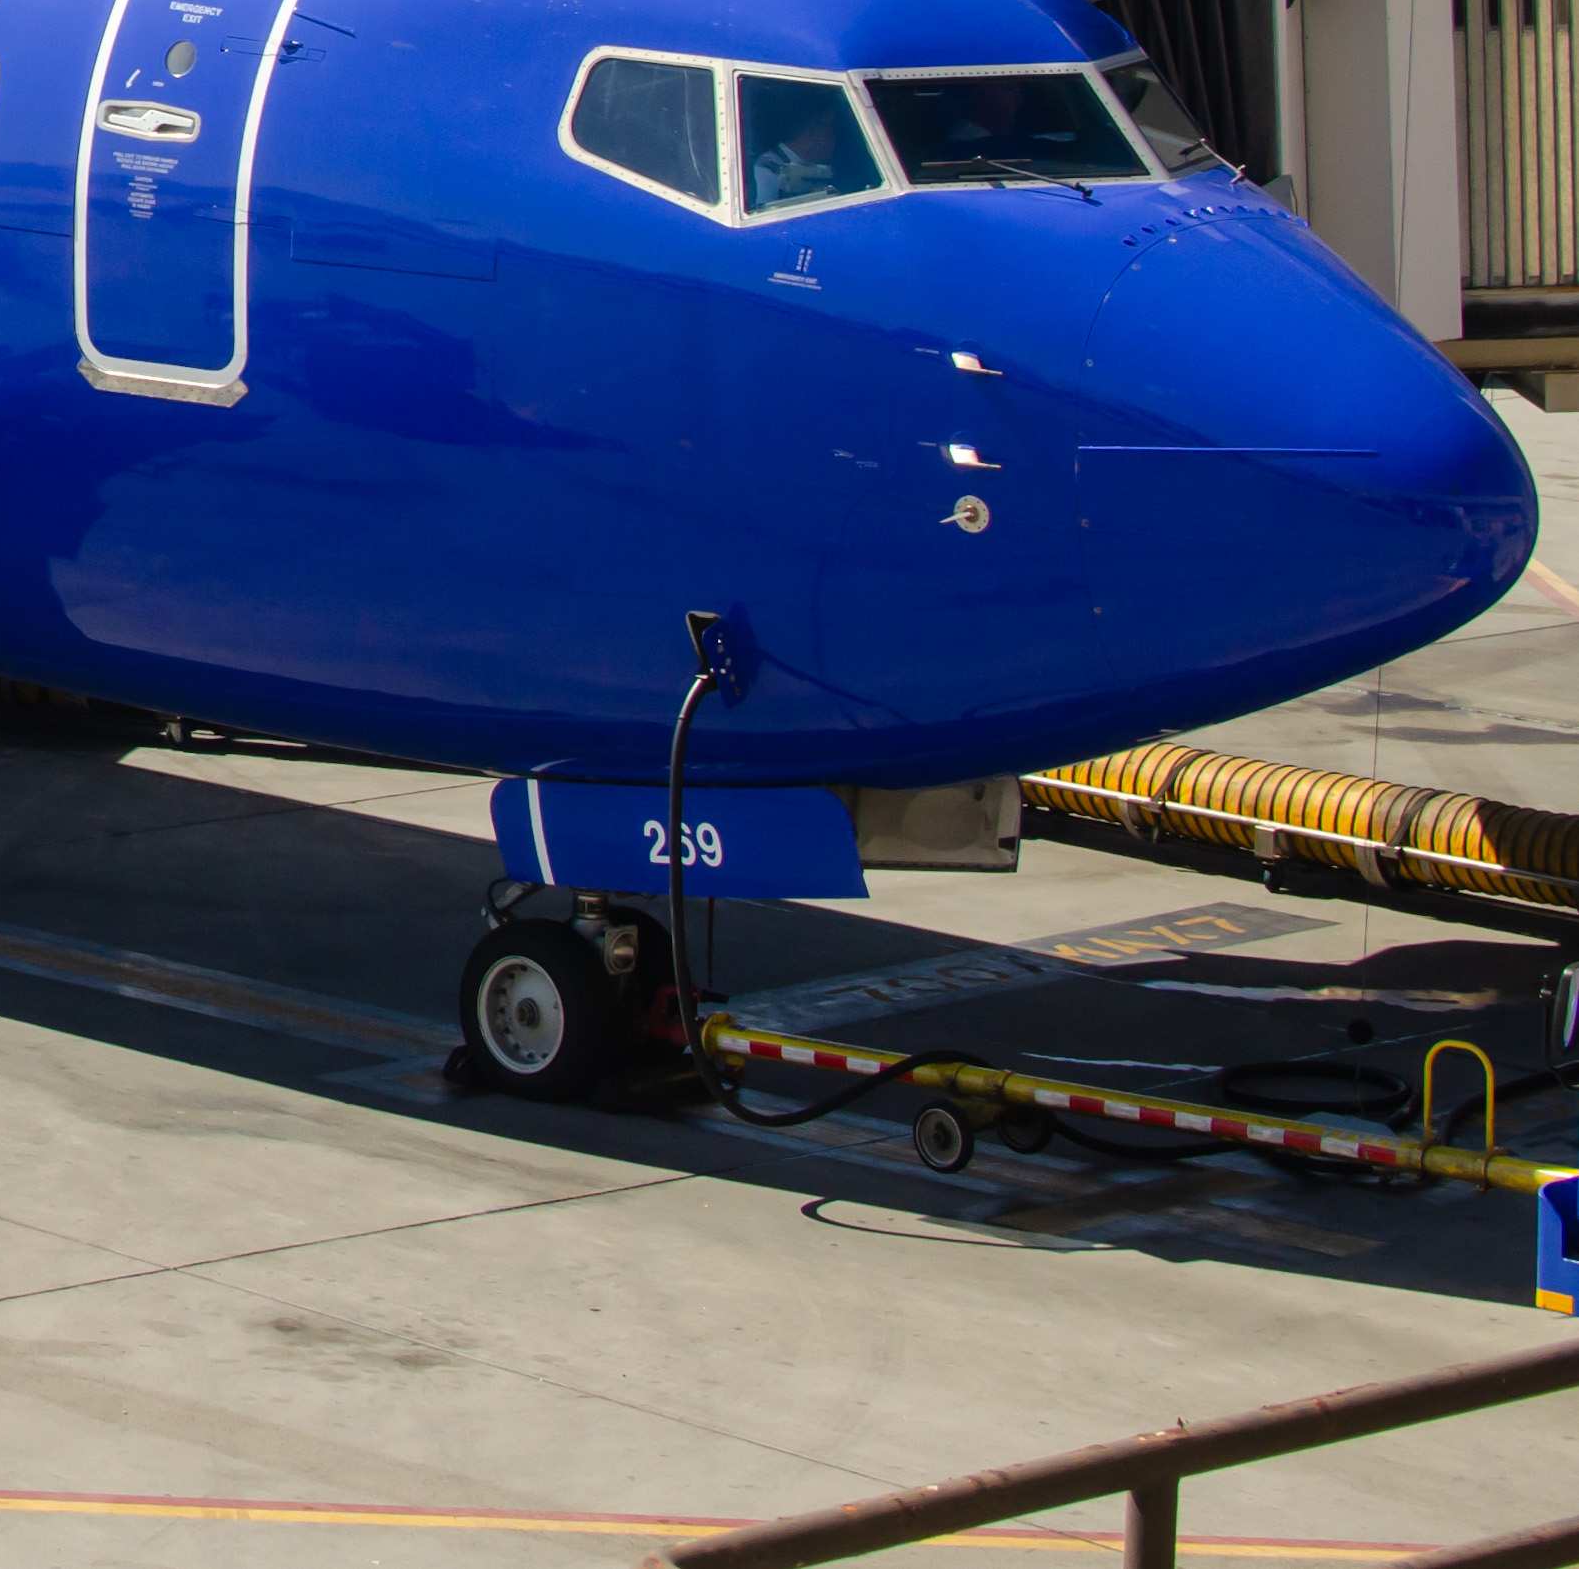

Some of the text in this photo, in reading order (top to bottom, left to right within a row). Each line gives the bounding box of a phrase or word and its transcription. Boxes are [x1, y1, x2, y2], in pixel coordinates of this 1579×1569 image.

[169, 0, 223, 17] EMERGENCY
[181, 12, 203, 24] EXIT
[643, 819, 724, 868] 269
